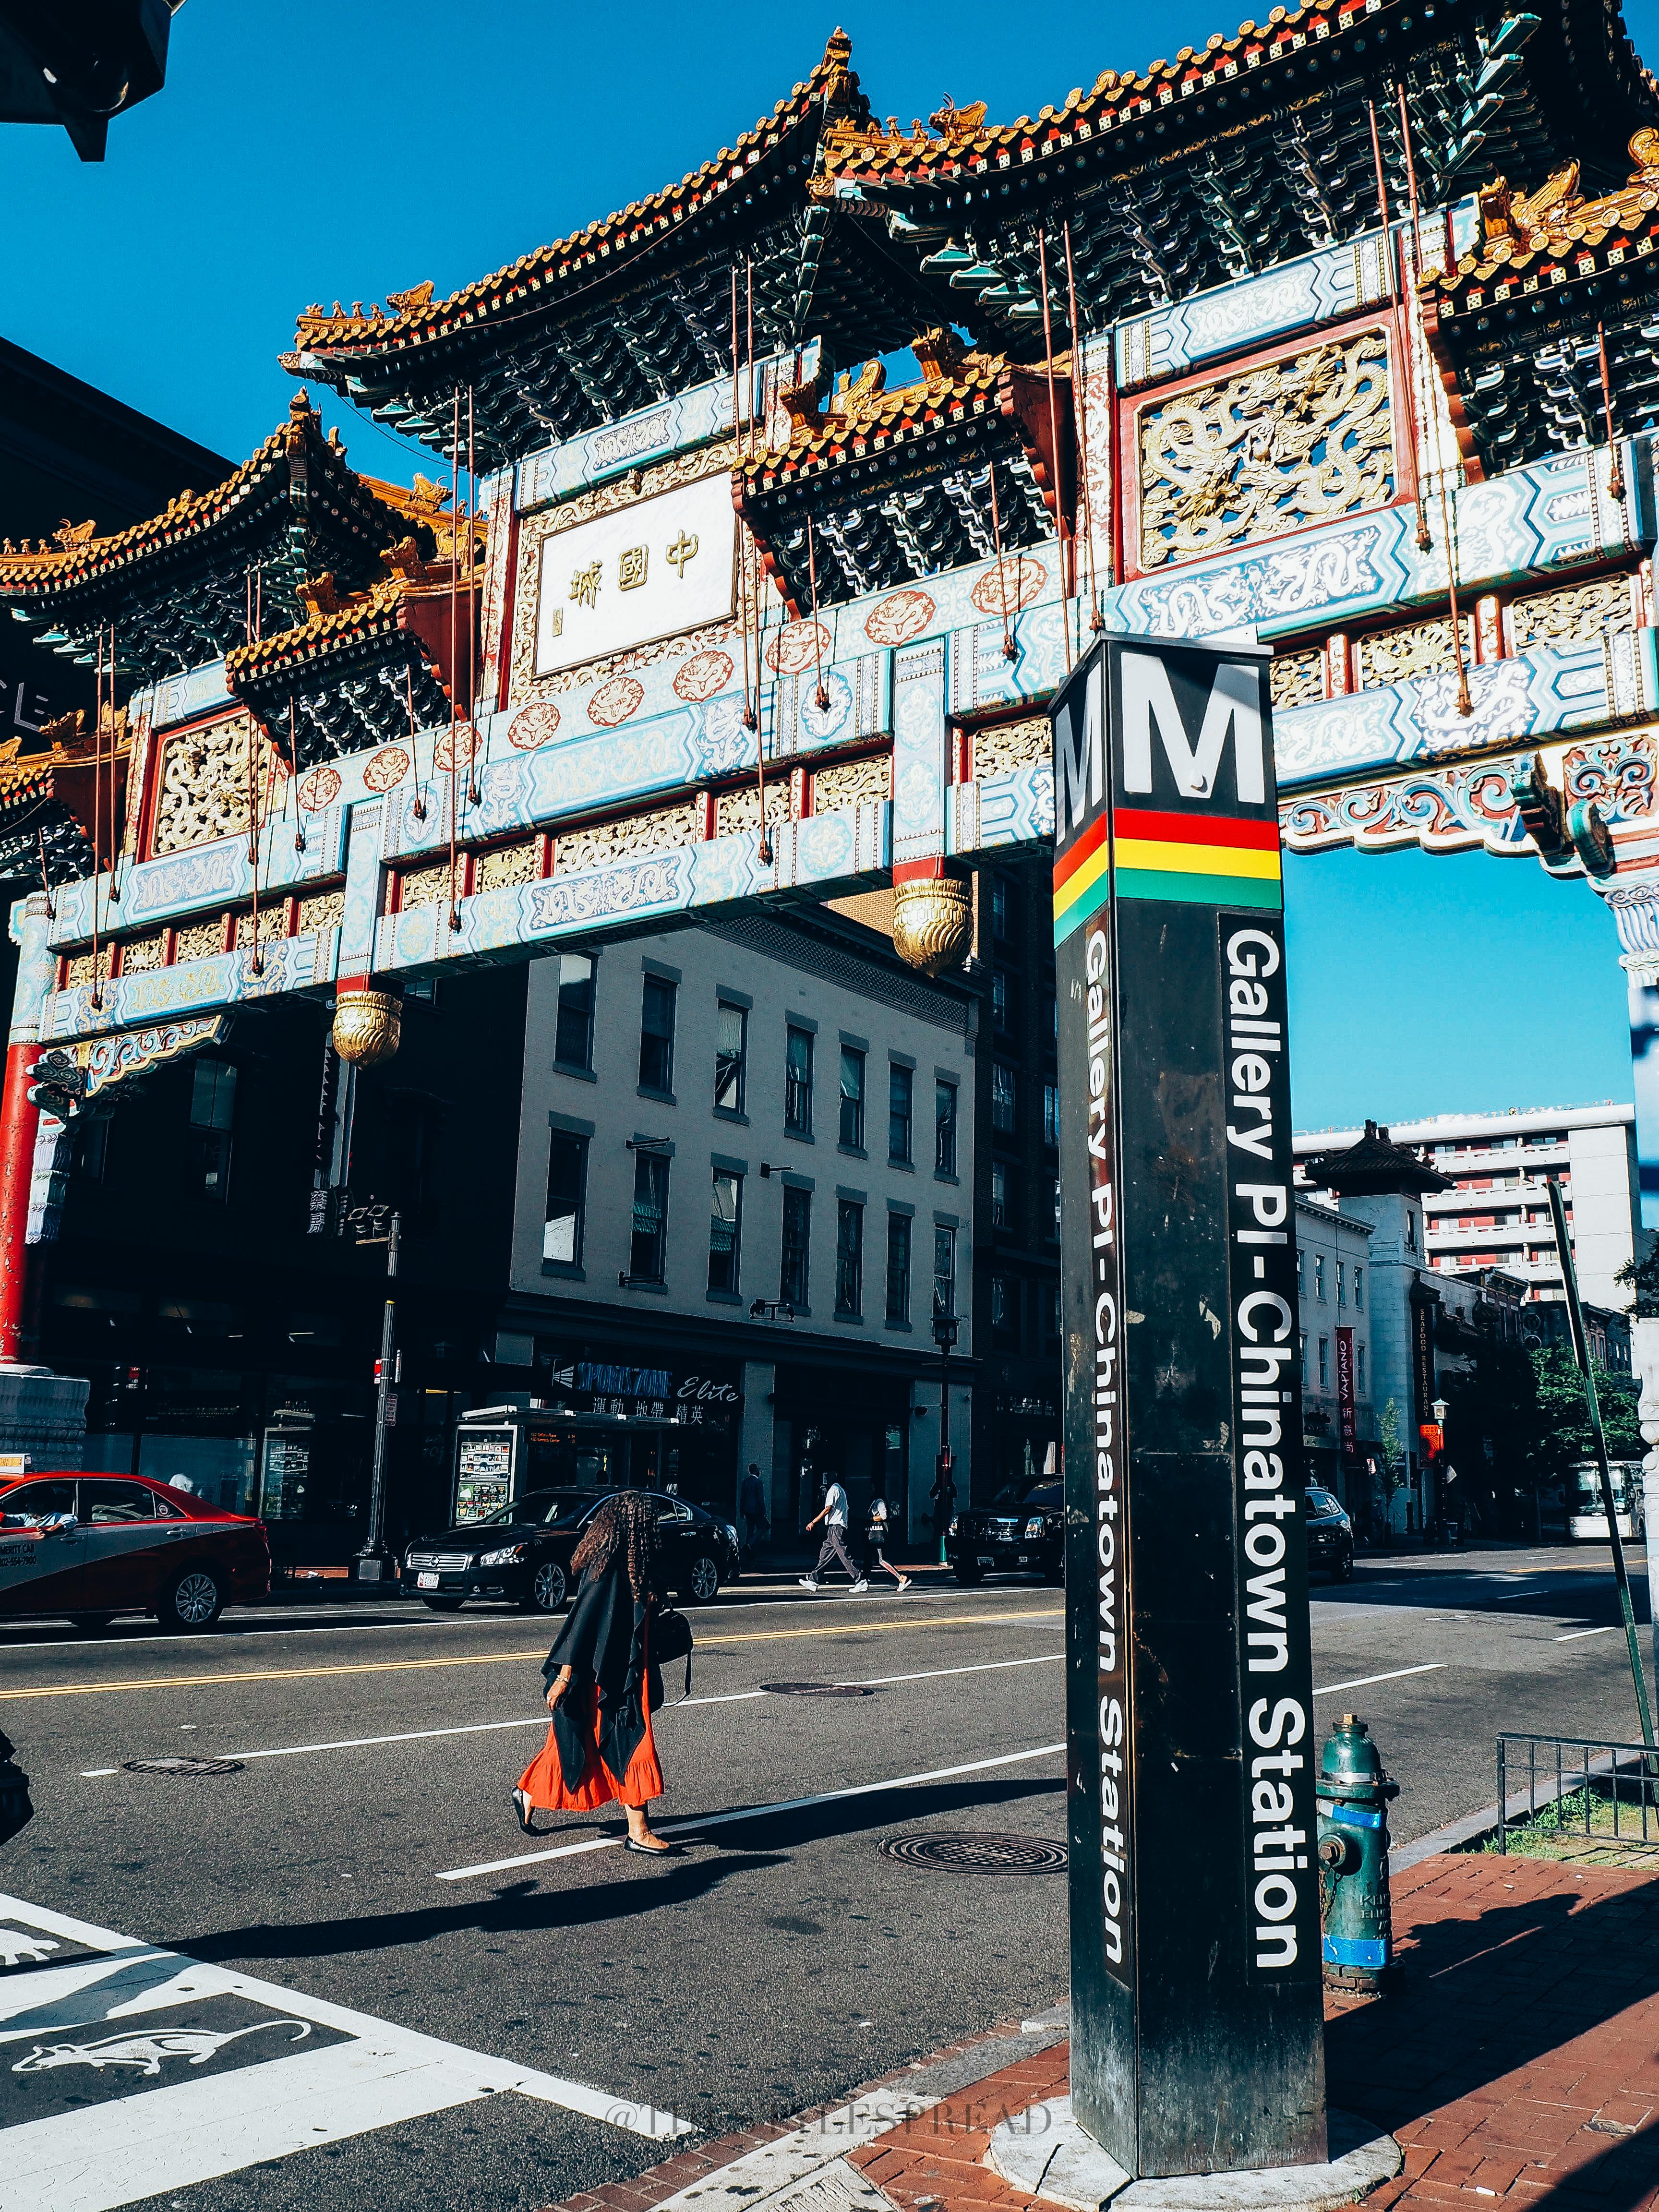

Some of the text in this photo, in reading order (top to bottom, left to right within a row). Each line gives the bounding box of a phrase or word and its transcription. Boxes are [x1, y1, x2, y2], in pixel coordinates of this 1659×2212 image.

[1056, 661, 1103, 847] M
[1120, 652, 1265, 804] M
[1226, 929, 1282, 1161] Gallery
[577, 1362, 739, 1401] SPORTS ZONE Elite
[1086, 929, 1109, 1160] Gallery
[1099, 1695, 1125, 1965] Station
[23, 1543, 35, 1553] CAB
[1248, 1697, 1308, 1968] Station
